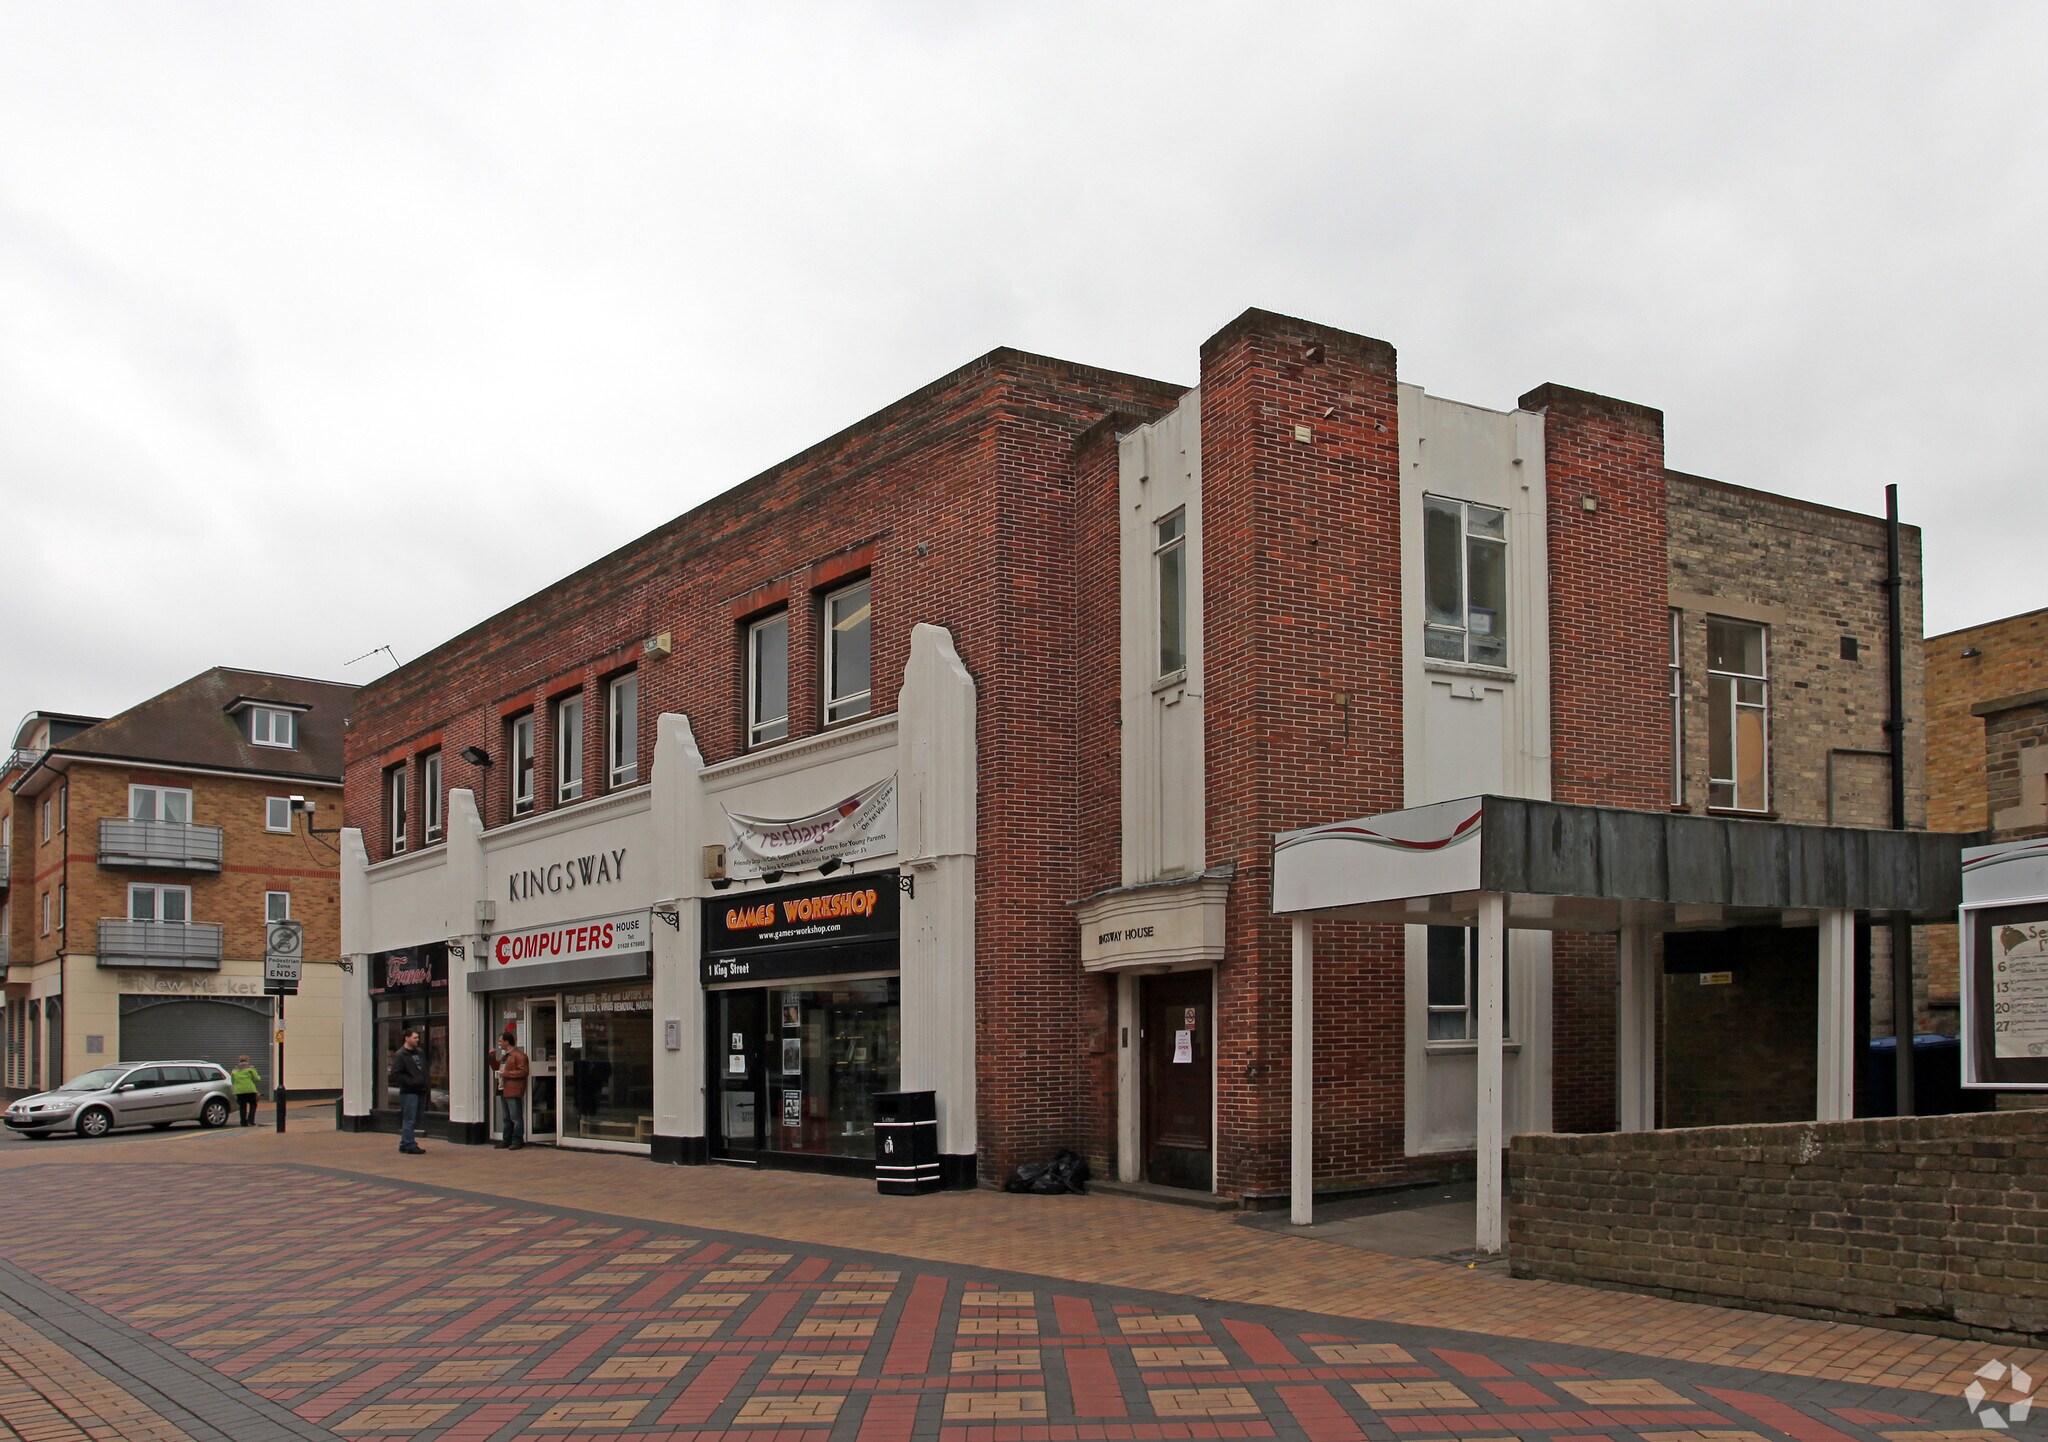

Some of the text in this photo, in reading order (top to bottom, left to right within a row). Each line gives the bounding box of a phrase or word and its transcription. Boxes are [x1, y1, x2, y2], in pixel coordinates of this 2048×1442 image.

[852, 817, 864, 830] Free
[863, 803, 877, 818] Drink
[880, 787, 893, 800] Cake
[861, 821, 870, 831] On
[868, 813, 878, 823] 1st
[875, 802, 888, 815] Visit
[760, 819, 841, 849] re:charge
[733, 858, 751, 867] Friendly
[777, 852, 797, 862] Support
[802, 848, 819, 856] Advice
[819, 844, 838, 852] Centre
[848, 838, 866, 847] Young
[866, 834, 887, 843] Parents
[781, 860, 801, 869] Creative
[800, 856, 822, 866] Activities
[844, 849, 860, 857] under
[509, 848, 626, 902] KINGSWAY
[726, 889, 878, 930] GAMES WORKSHOP
[616, 920, 640, 932] HOUSE
[758, 923, 841, 940] www.games-workshop.com
[1124, 926, 1154, 940] HOUSE
[495, 922, 614, 965] COMPUTERS
[270, 970, 297, 978] ENDS
[708, 962, 750, 978] 1 King Street
[1997, 961, 2007, 972] 6
[138, 977, 184, 993] New
[1996, 982, 2010, 993] 13
[503, 1010, 517, 1019] Sales
[568, 1003, 585, 1013] CUSTOM
[585, 1002, 597, 1012] BUILT
[600, 1001, 614, 1012] VIRUS
[1995, 1002, 2010, 1014] 20
[1995, 1020, 2010, 1032] 27
